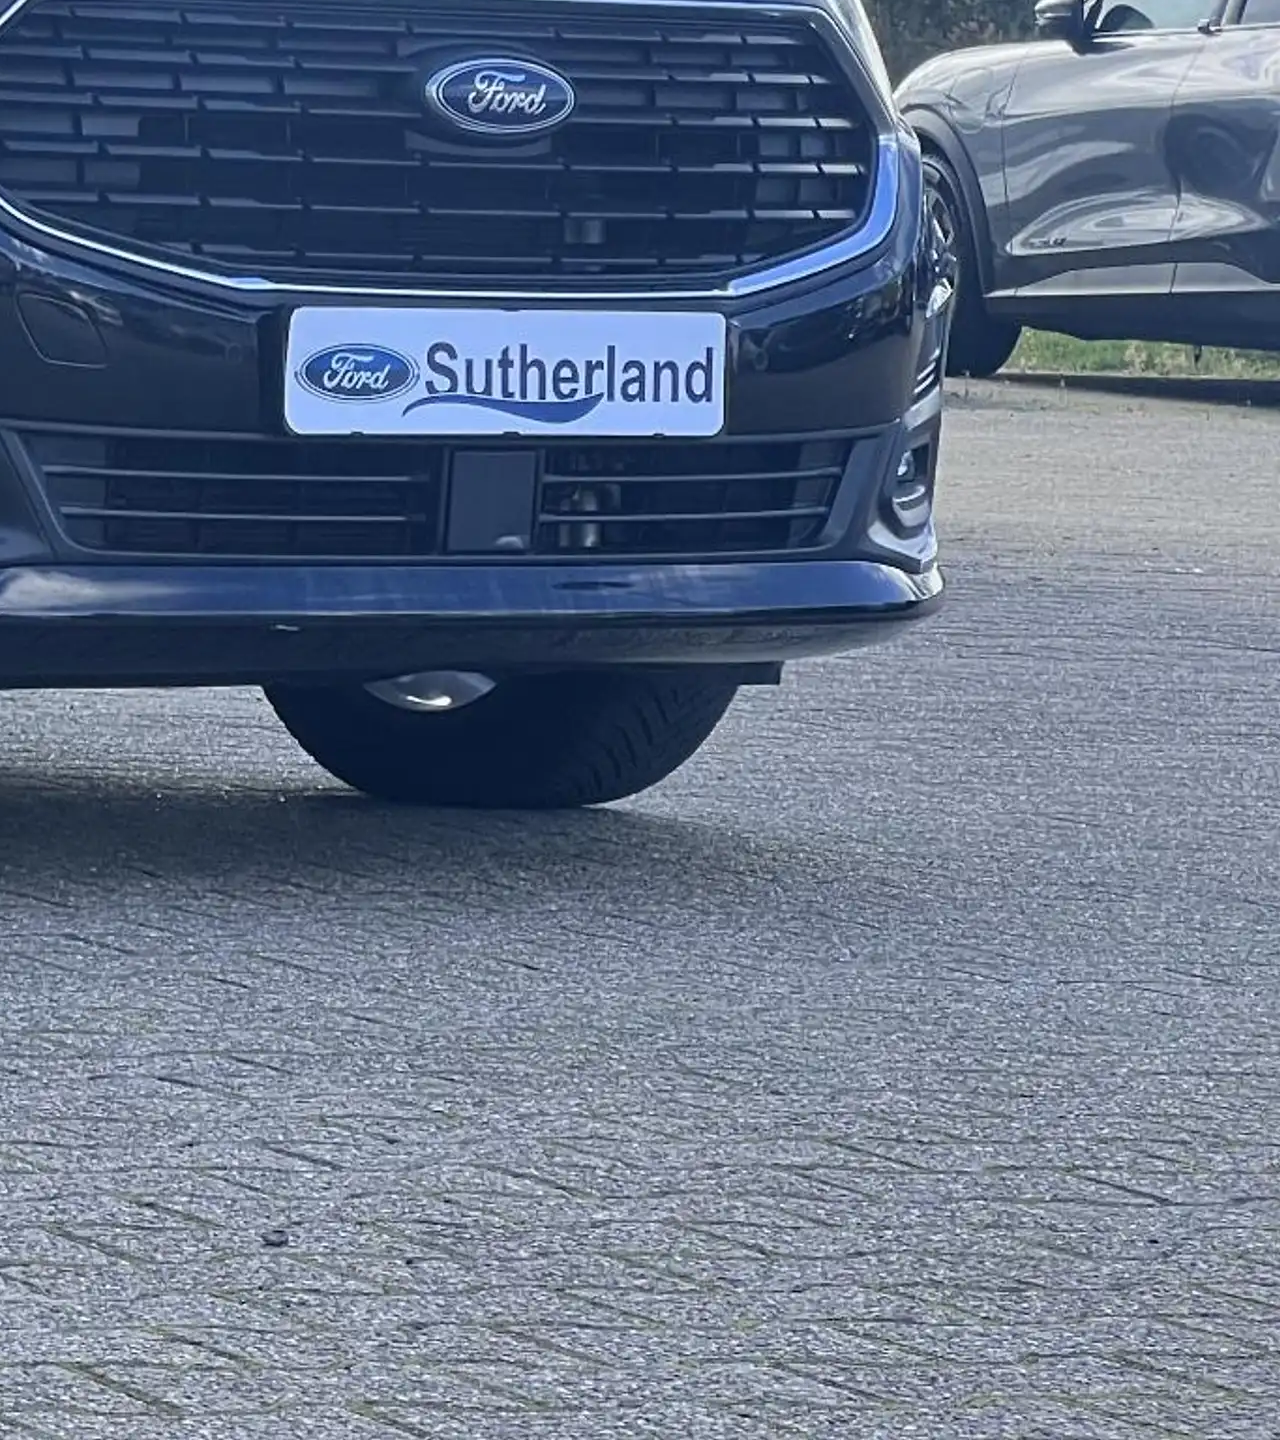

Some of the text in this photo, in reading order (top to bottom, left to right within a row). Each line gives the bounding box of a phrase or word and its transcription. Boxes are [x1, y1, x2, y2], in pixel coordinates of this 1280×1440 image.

[468, 70, 547, 115] Ford
[322, 341, 714, 403] Ford Sutherland
